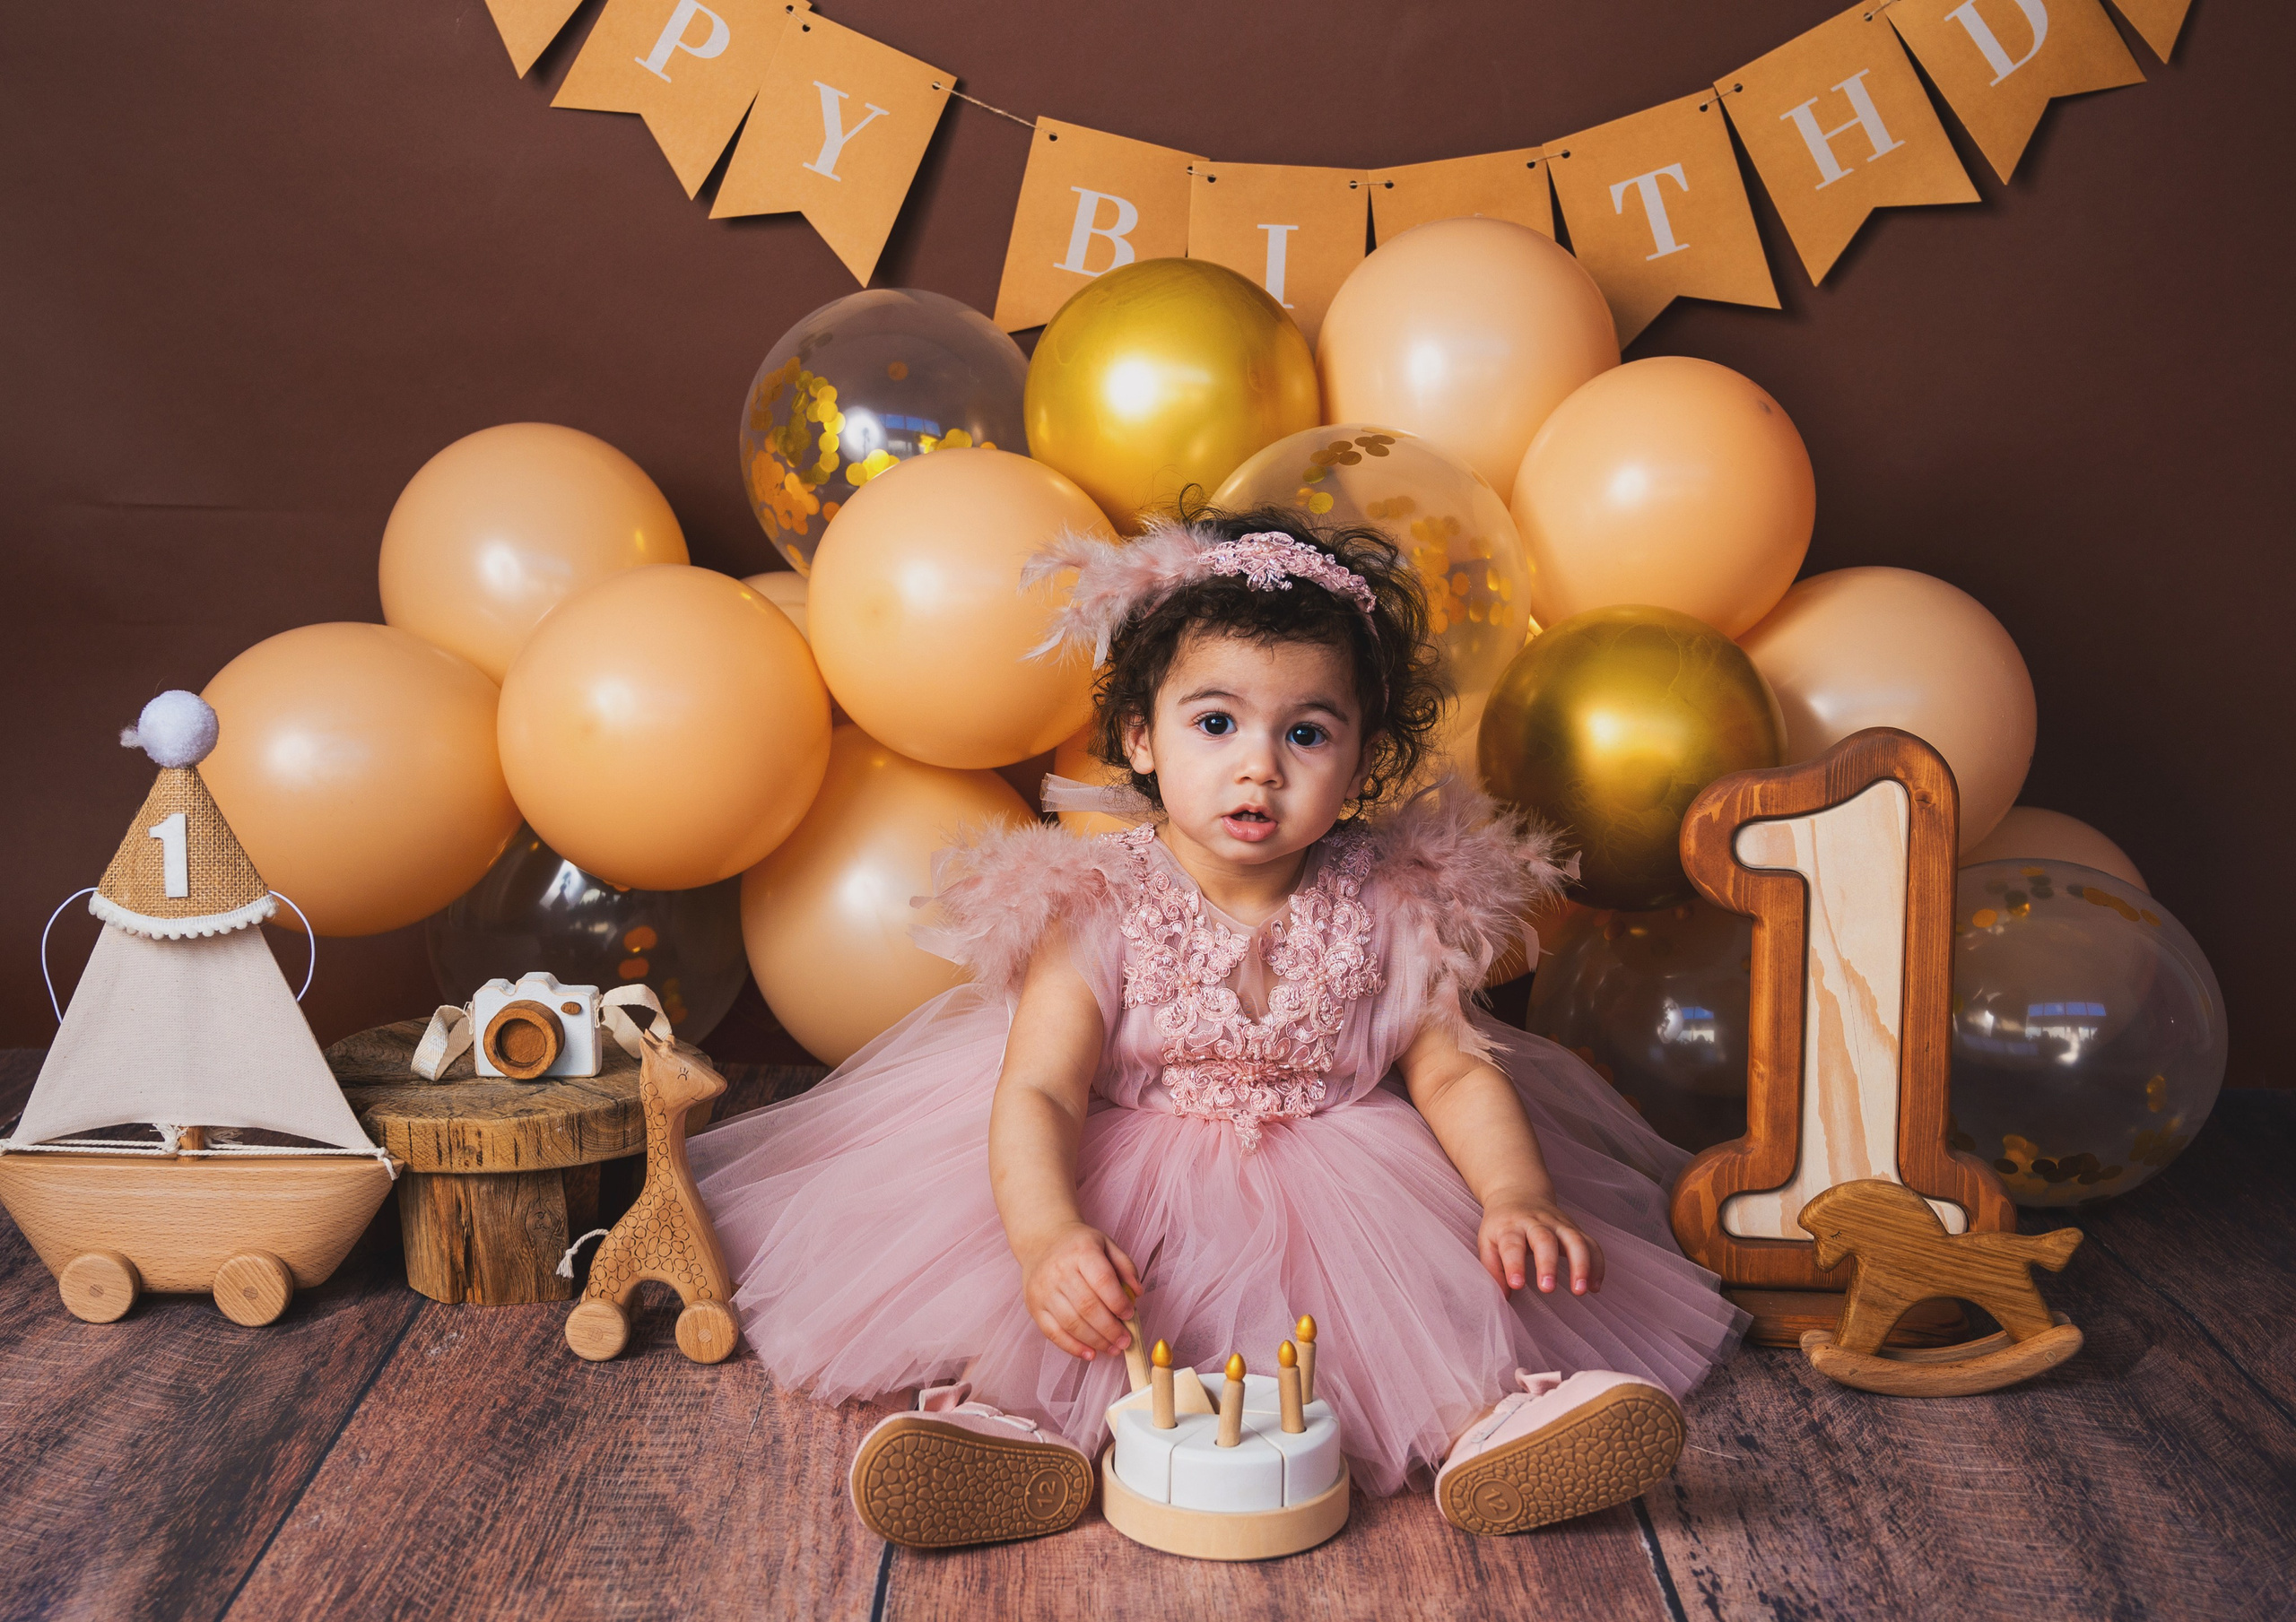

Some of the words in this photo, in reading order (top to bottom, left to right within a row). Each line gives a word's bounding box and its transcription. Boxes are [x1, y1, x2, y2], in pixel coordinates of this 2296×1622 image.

[1053, 0, 2049, 309] BITHD
[148, 812, 189, 898] 1
[1670, 726, 2017, 1291] 1
[1037, 1480, 1057, 1507] 12
[1484, 1488, 1509, 1515] 12
